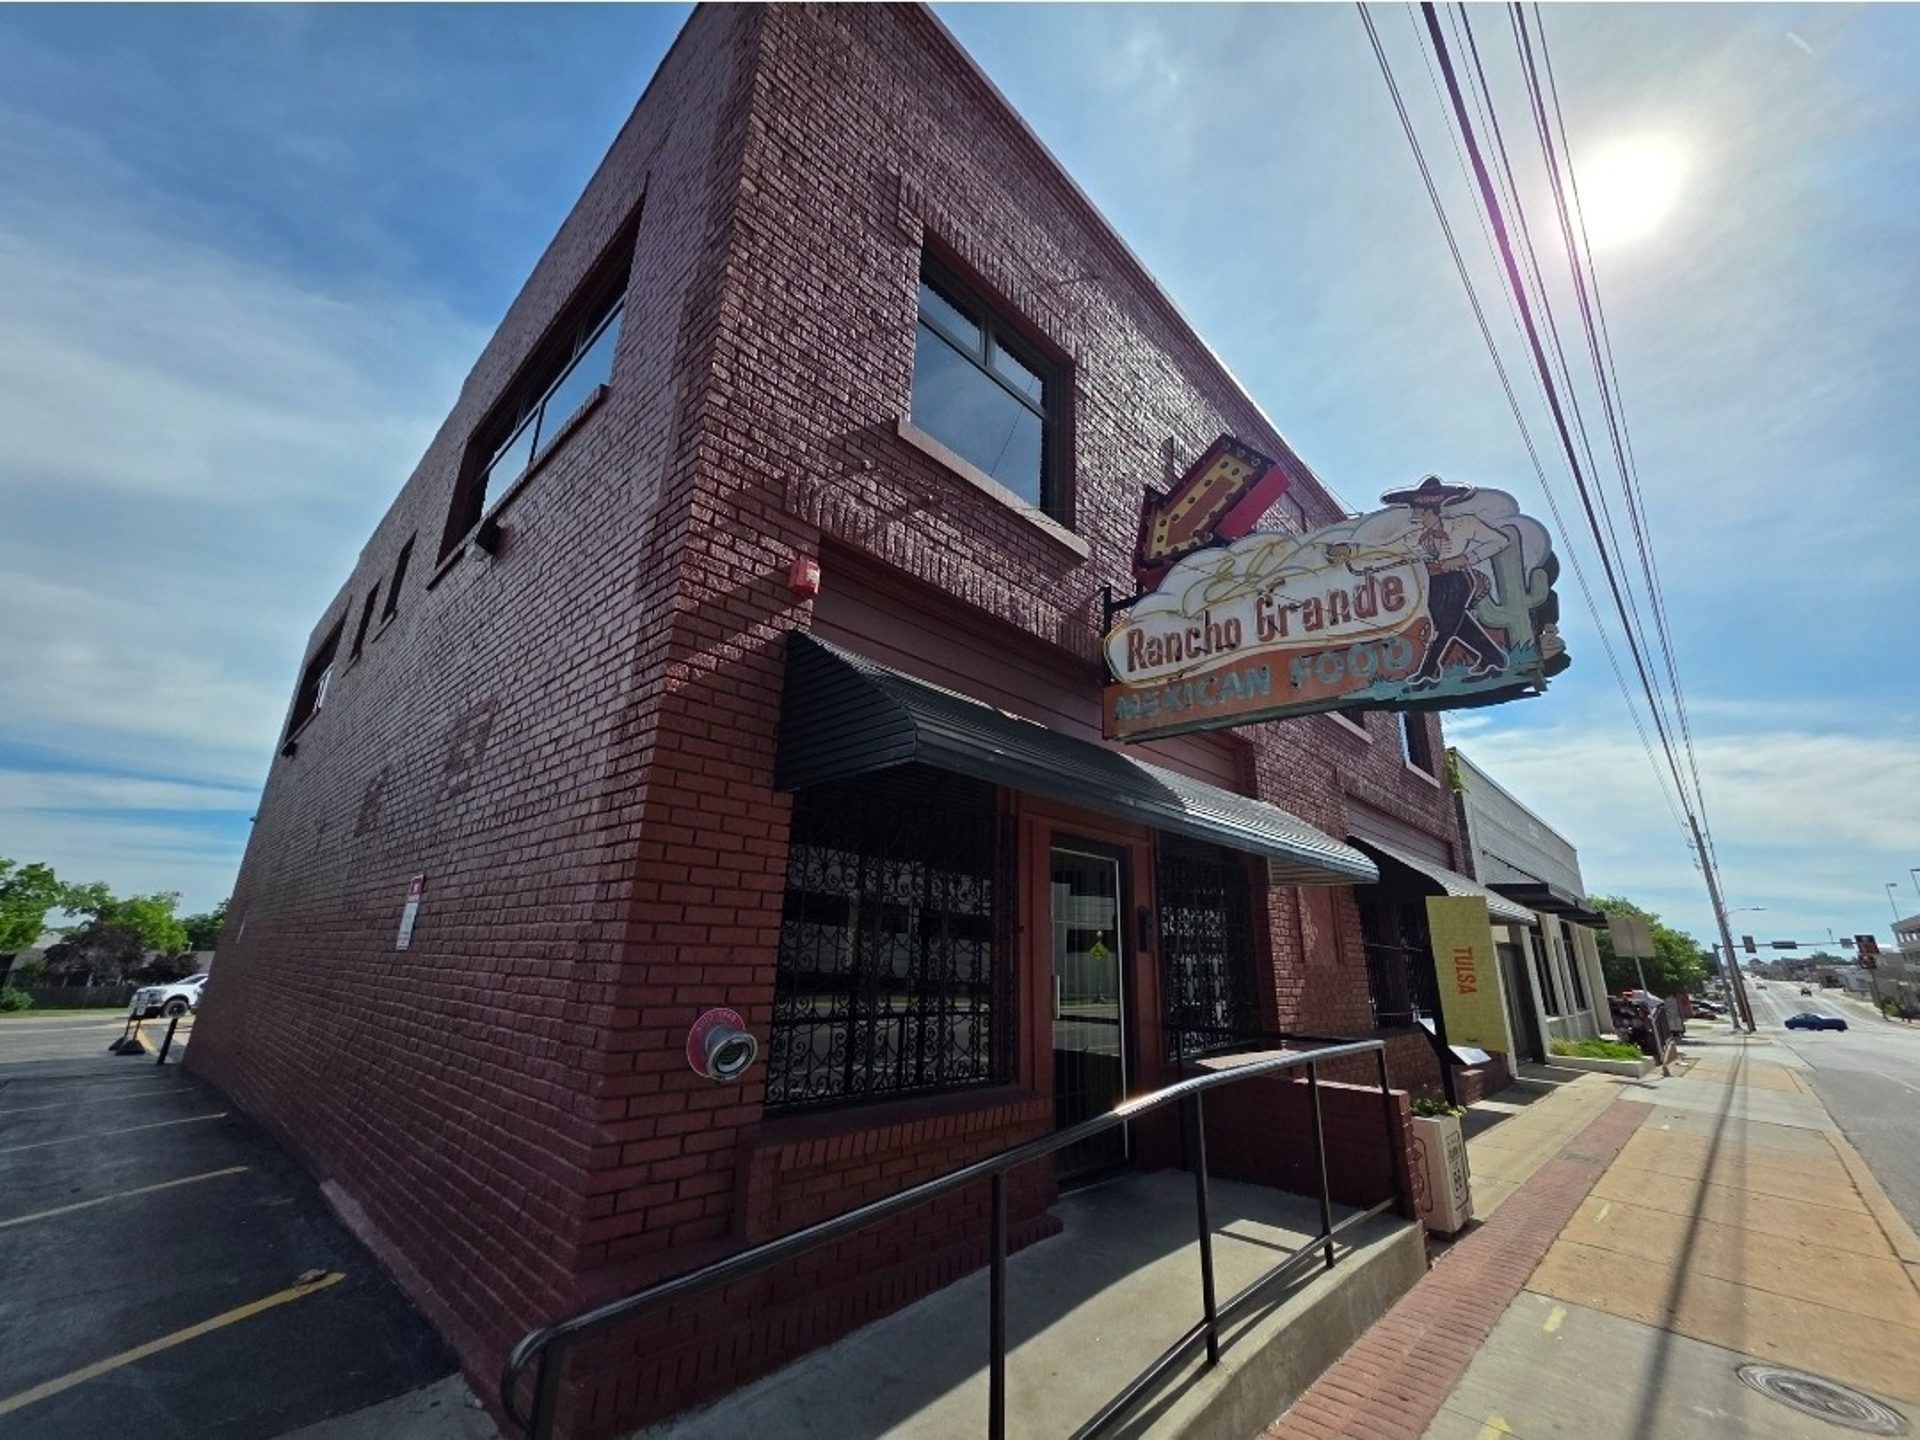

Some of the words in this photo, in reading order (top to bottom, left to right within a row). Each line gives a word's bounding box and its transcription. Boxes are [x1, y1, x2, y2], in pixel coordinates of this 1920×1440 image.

[1127, 609, 1241, 673] Rancho
[1255, 566, 1407, 642] Grande
[1115, 665, 1271, 721] MEXICAN
[1290, 637, 1412, 687] FOOD
[1454, 946, 1477, 994] TULSA
